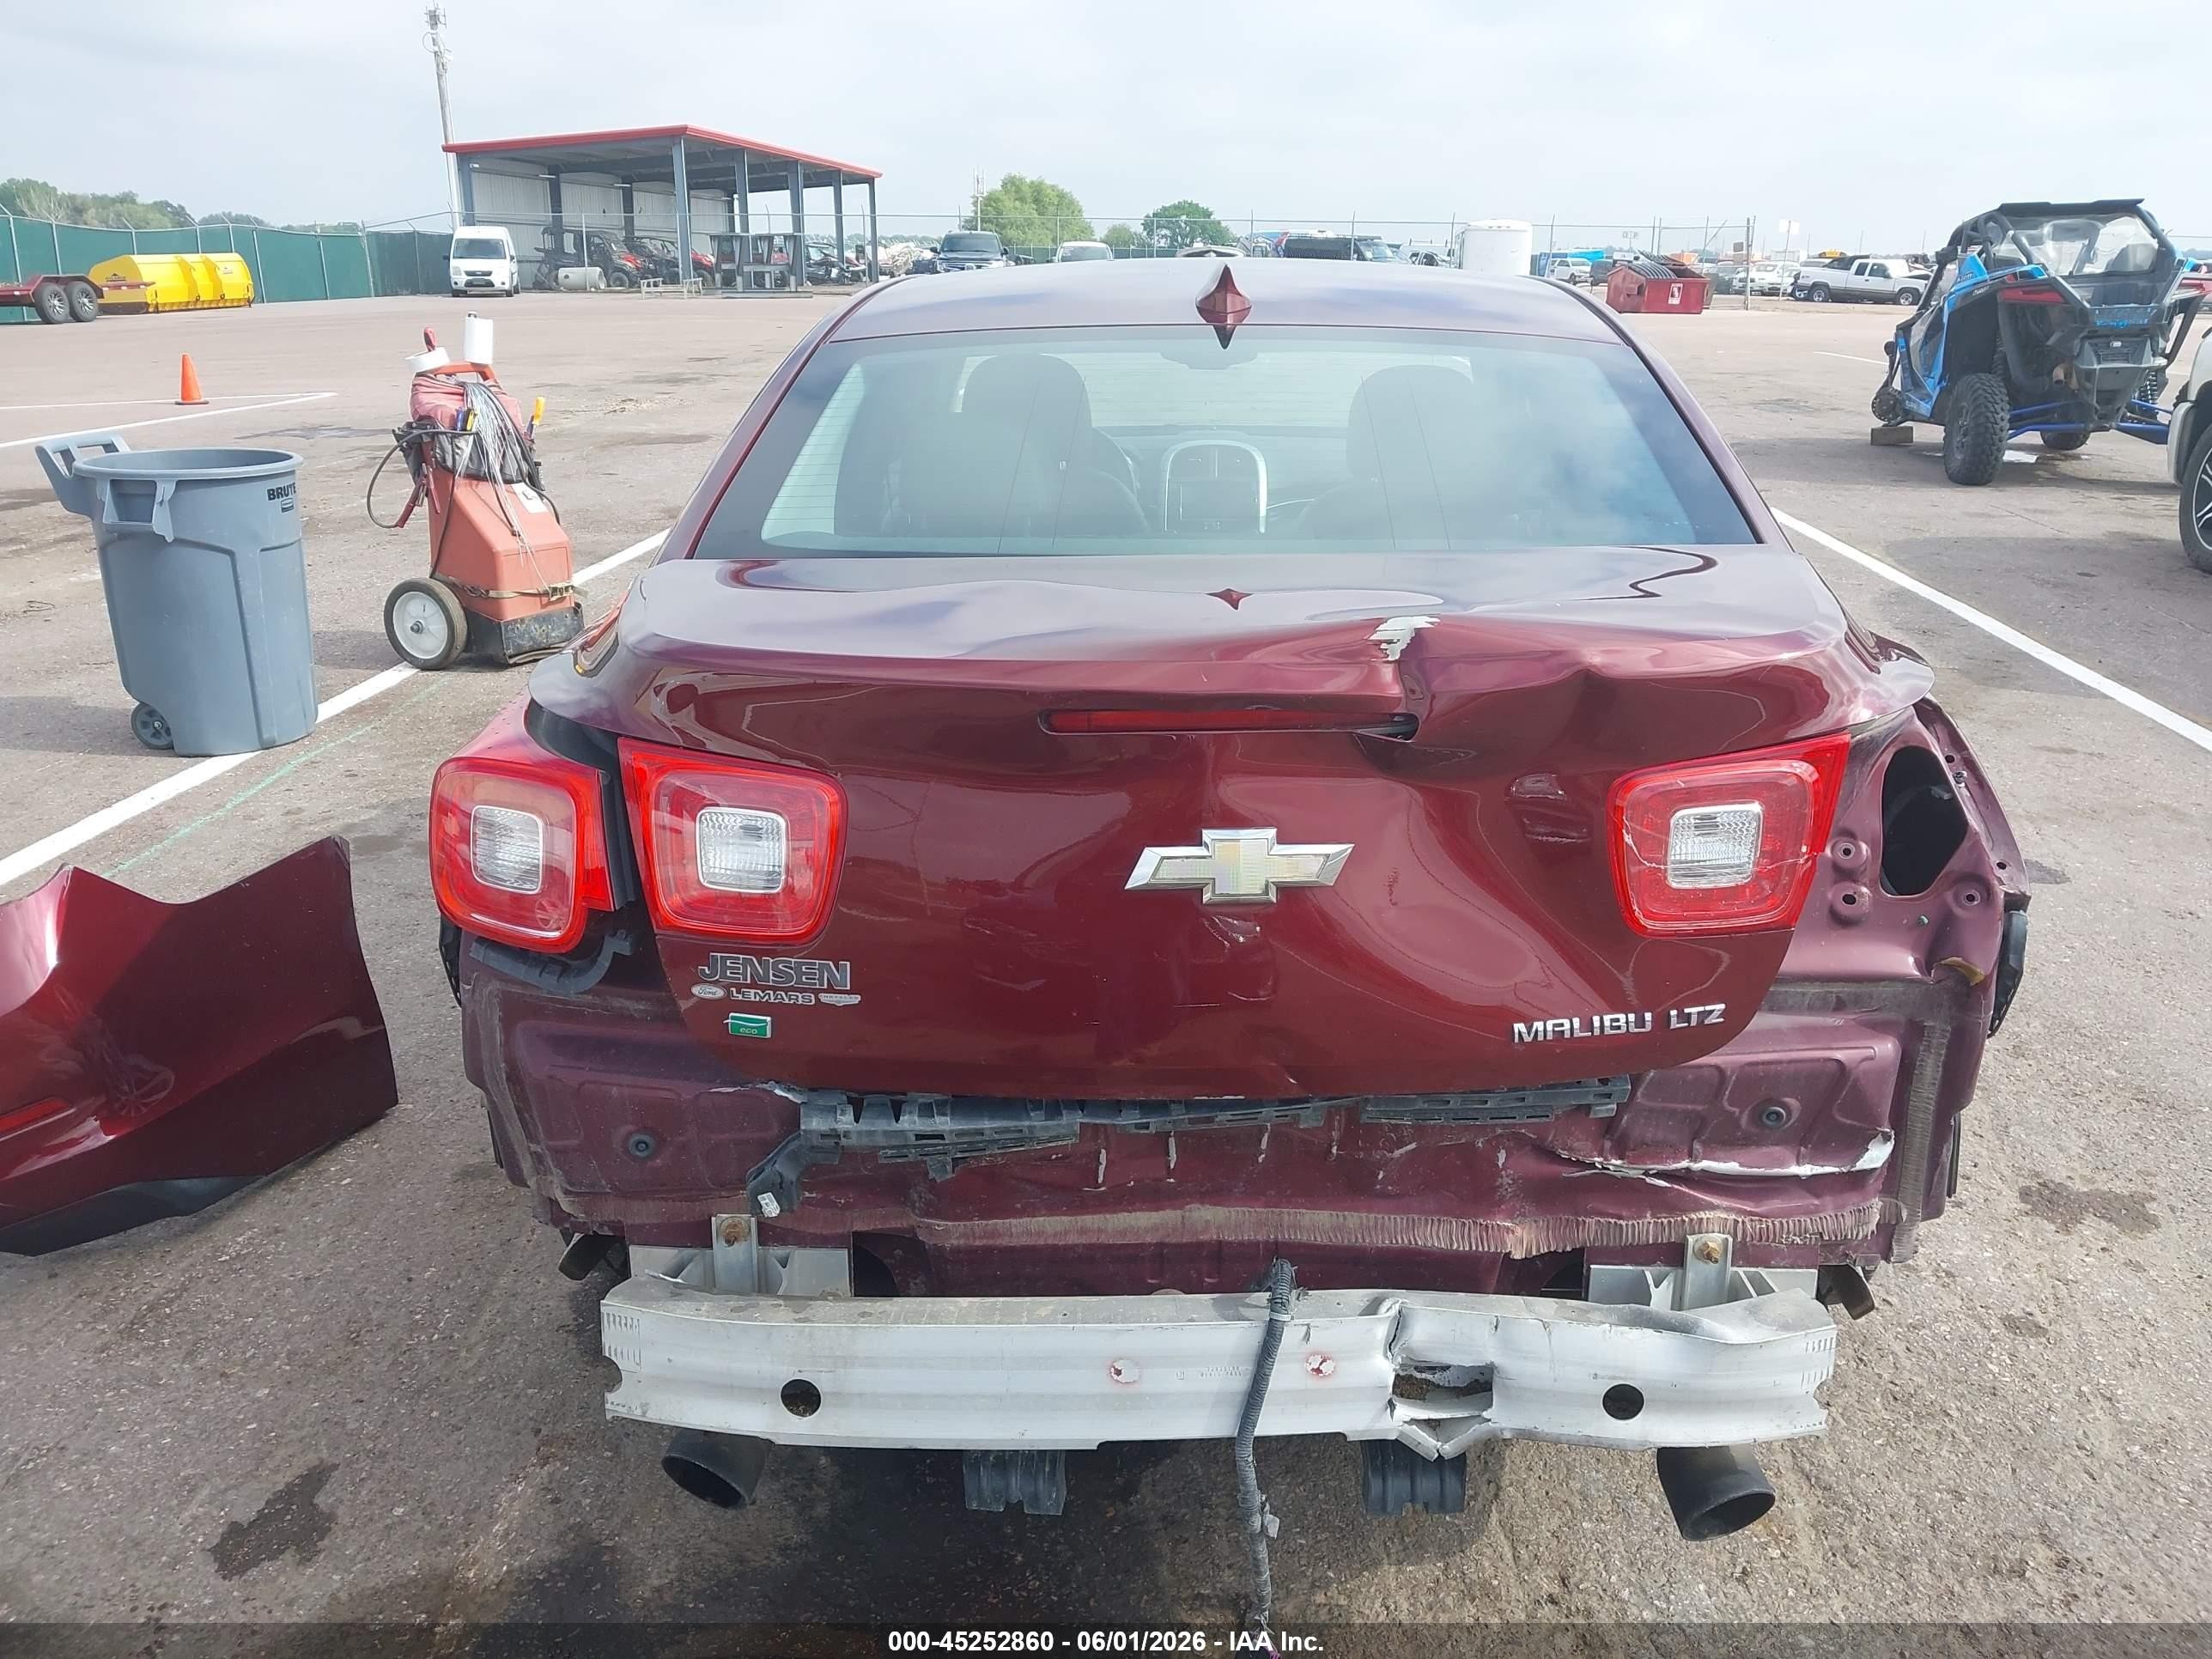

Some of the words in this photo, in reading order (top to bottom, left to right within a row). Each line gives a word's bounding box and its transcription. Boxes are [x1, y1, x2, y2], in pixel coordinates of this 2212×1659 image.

[698, 952, 852, 989] JENSEN
[730, 988, 815, 1006] LEMARS
[1513, 1012, 1653, 1043] MALIBU
[1669, 1003, 1727, 1030] LTZ
